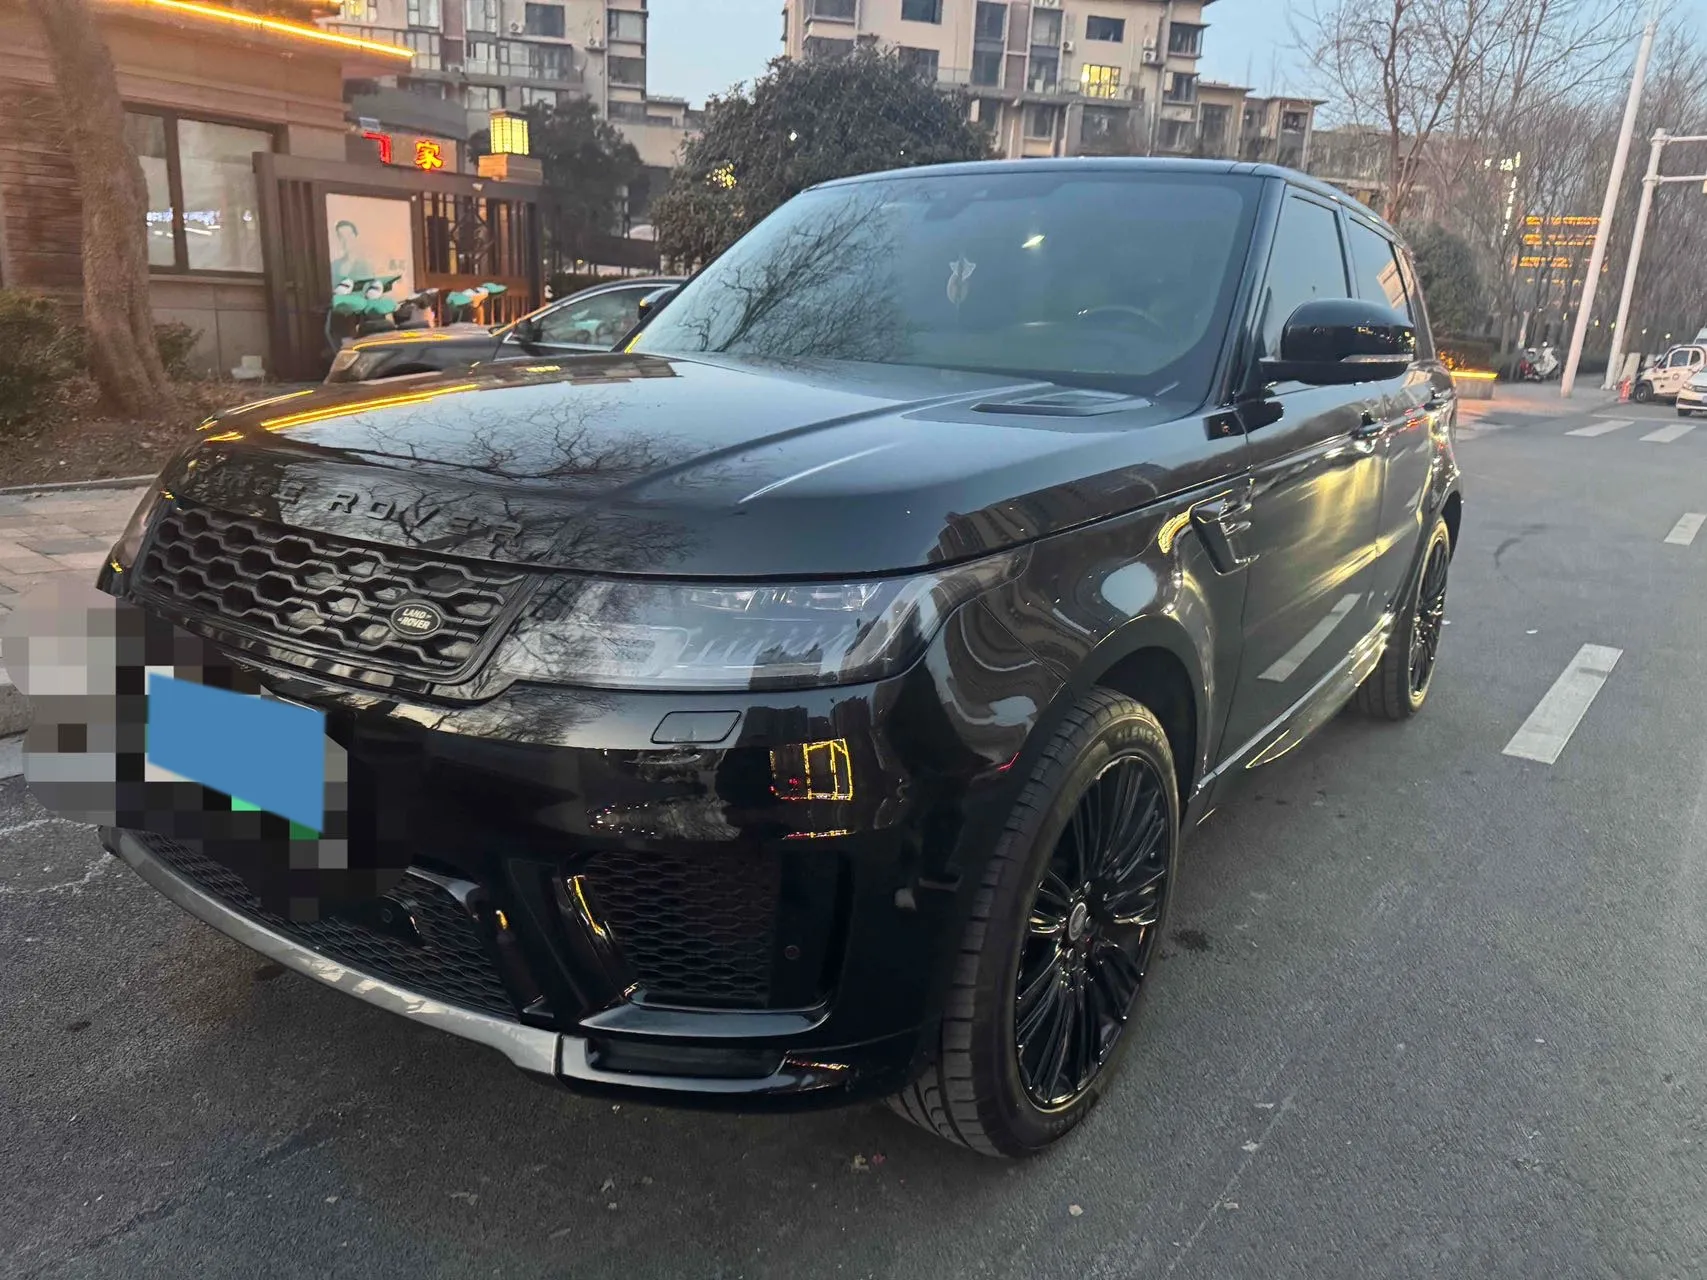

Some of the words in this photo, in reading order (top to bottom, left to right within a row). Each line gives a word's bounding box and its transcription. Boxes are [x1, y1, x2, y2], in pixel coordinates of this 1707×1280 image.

[415, 140, 443, 170] 家
[328, 491, 523, 549] ROVER
[400, 617, 431, 630] ROVER
[402, 608, 427, 619] LAND
